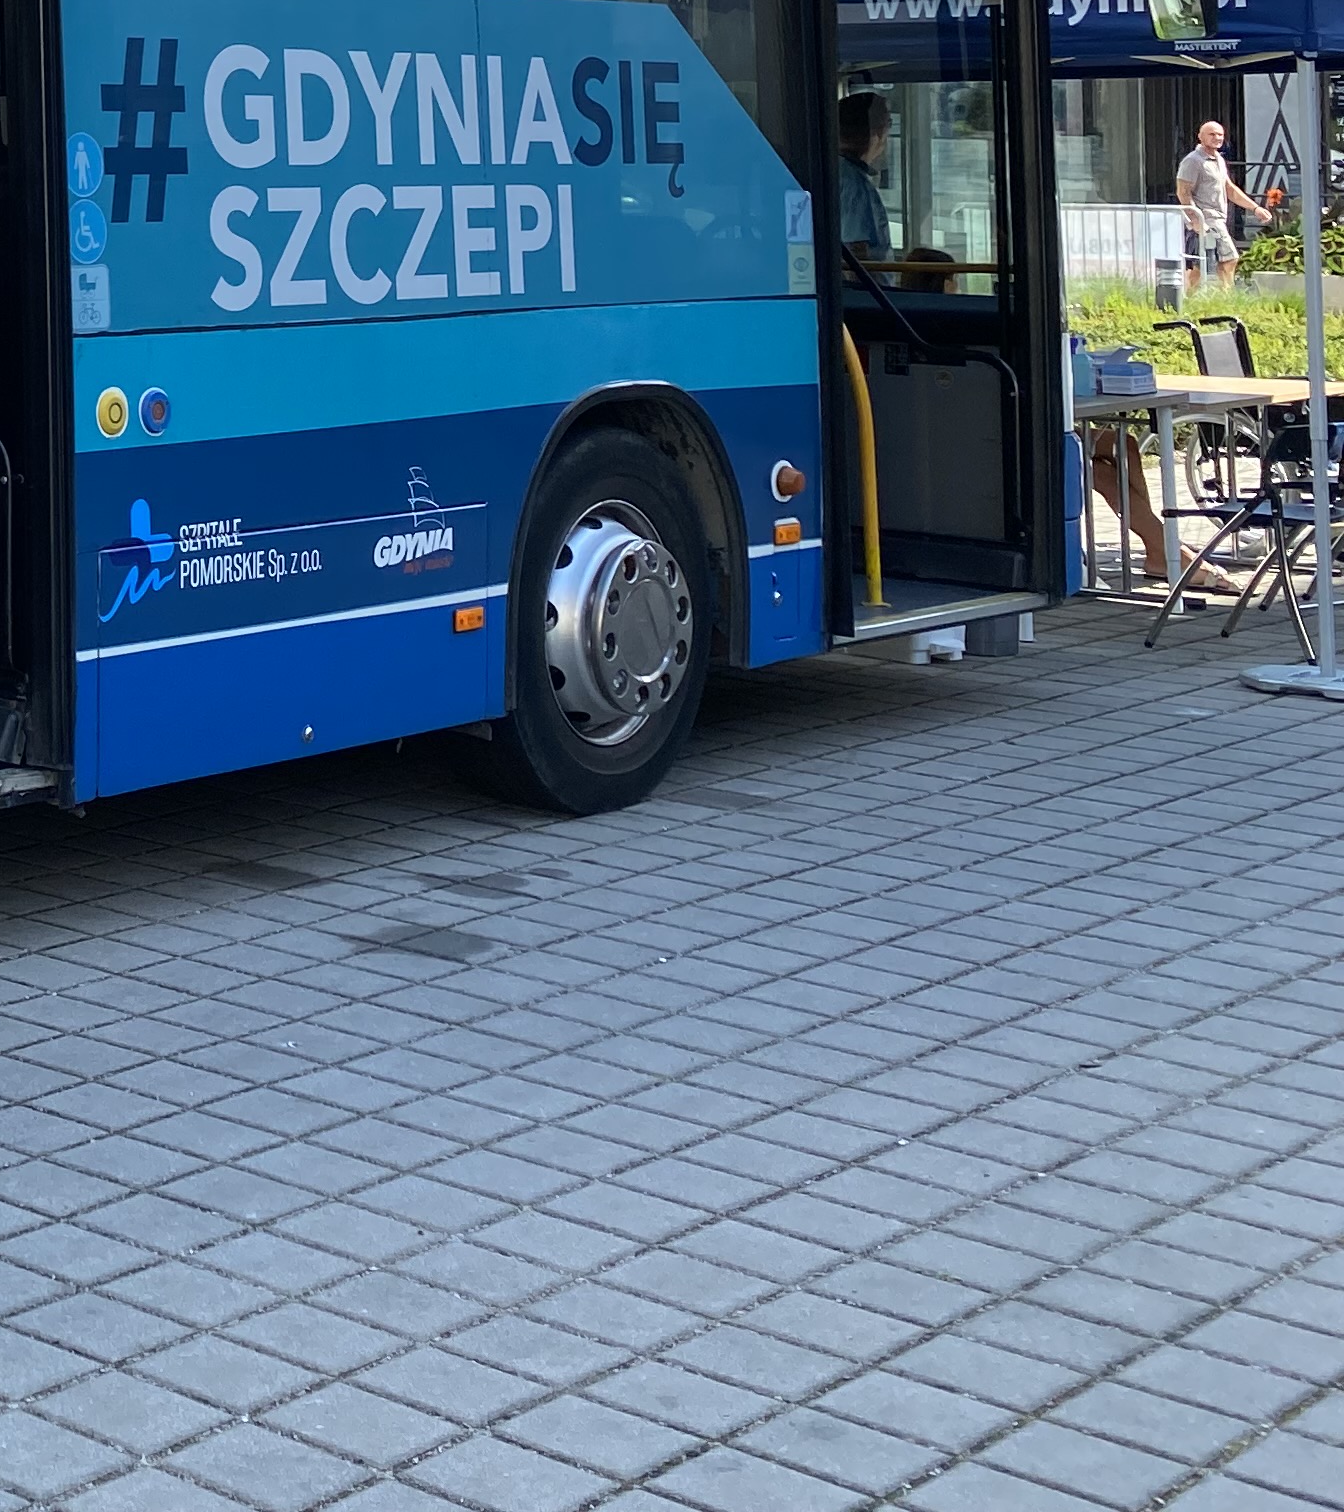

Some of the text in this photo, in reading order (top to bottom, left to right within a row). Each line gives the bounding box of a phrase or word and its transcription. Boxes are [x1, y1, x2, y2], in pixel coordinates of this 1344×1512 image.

[209, 183, 577, 312] SZCZEPI
[179, 518, 243, 553] SZPITALE
[373, 527, 453, 568] GDYNIA
[180, 550, 265, 589] POMORSKIE
[268, 548, 288, 583] Sp.
[290, 552, 298, 574] z
